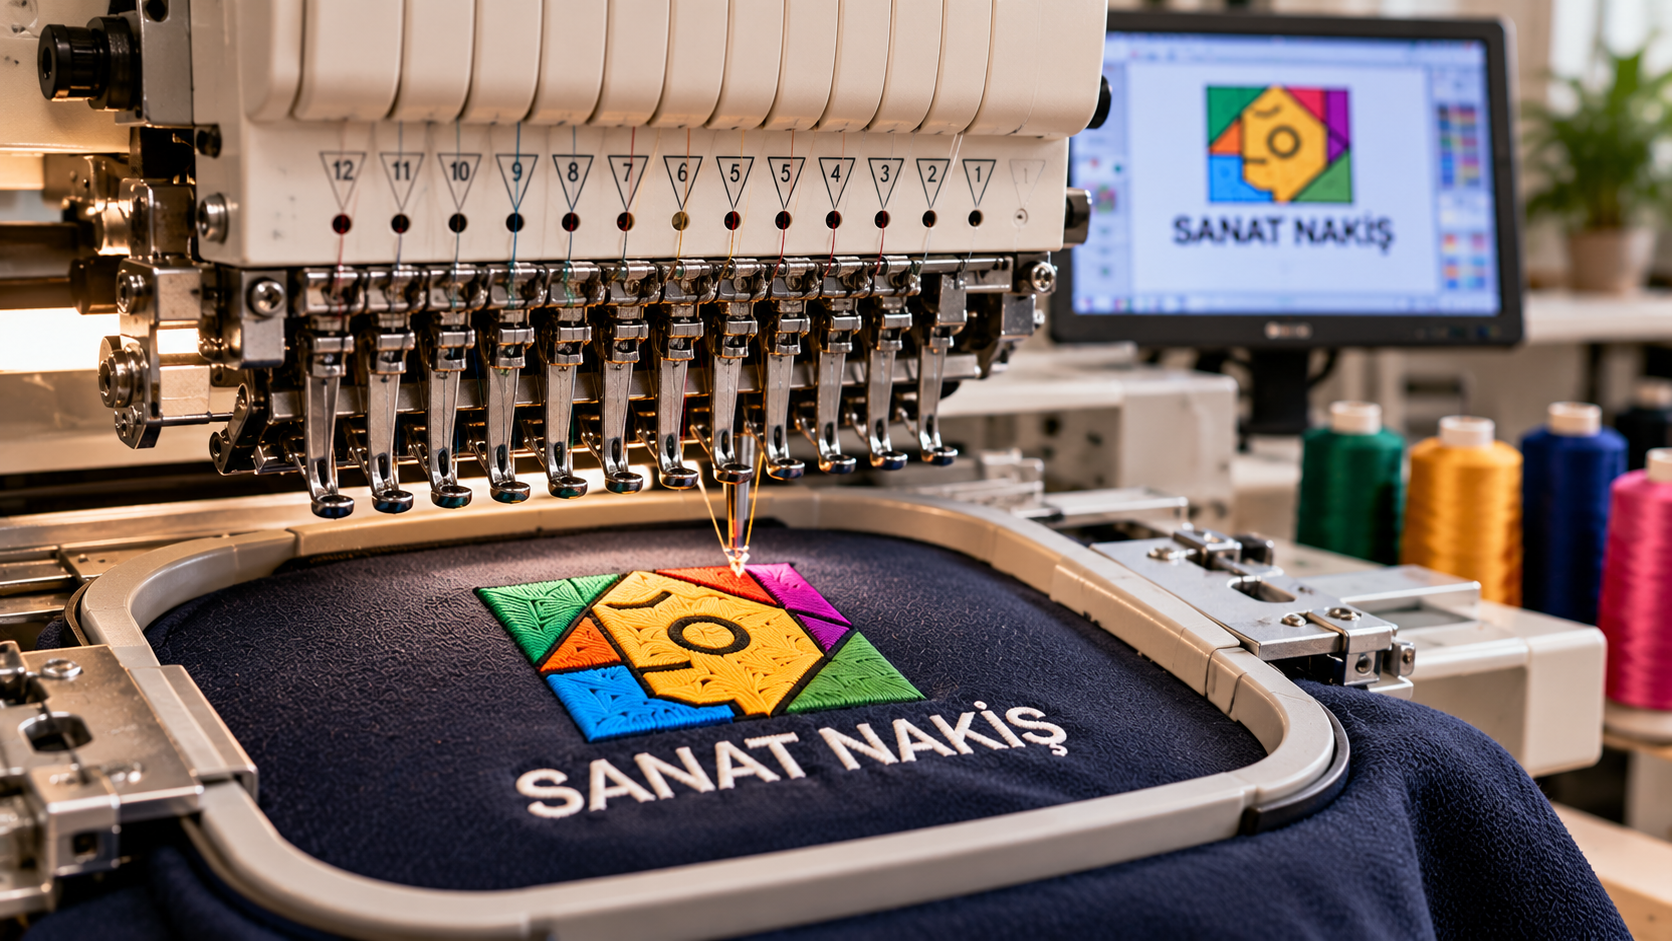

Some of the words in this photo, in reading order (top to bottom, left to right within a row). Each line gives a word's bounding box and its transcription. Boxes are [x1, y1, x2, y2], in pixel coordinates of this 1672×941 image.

[332, 160, 354, 182] 12
[391, 160, 411, 182] 11
[450, 160, 470, 182] 10
[511, 161, 523, 182] 9
[567, 162, 579, 182] 8
[623, 163, 634, 182] 7
[677, 162, 688, 183] 6
[729, 163, 740, 183] 5
[780, 163, 791, 183] 5
[830, 163, 841, 183] 4
[879, 164, 890, 183] 3
[927, 165, 937, 183] 2
[974, 165, 982, 183] 1
[1172, 216, 1284, 247] SANAT
[1293, 210, 1395, 255] NAKİŞ
[515, 731, 806, 819] SANAT
[817, 700, 1068, 771] NAKİŞ
